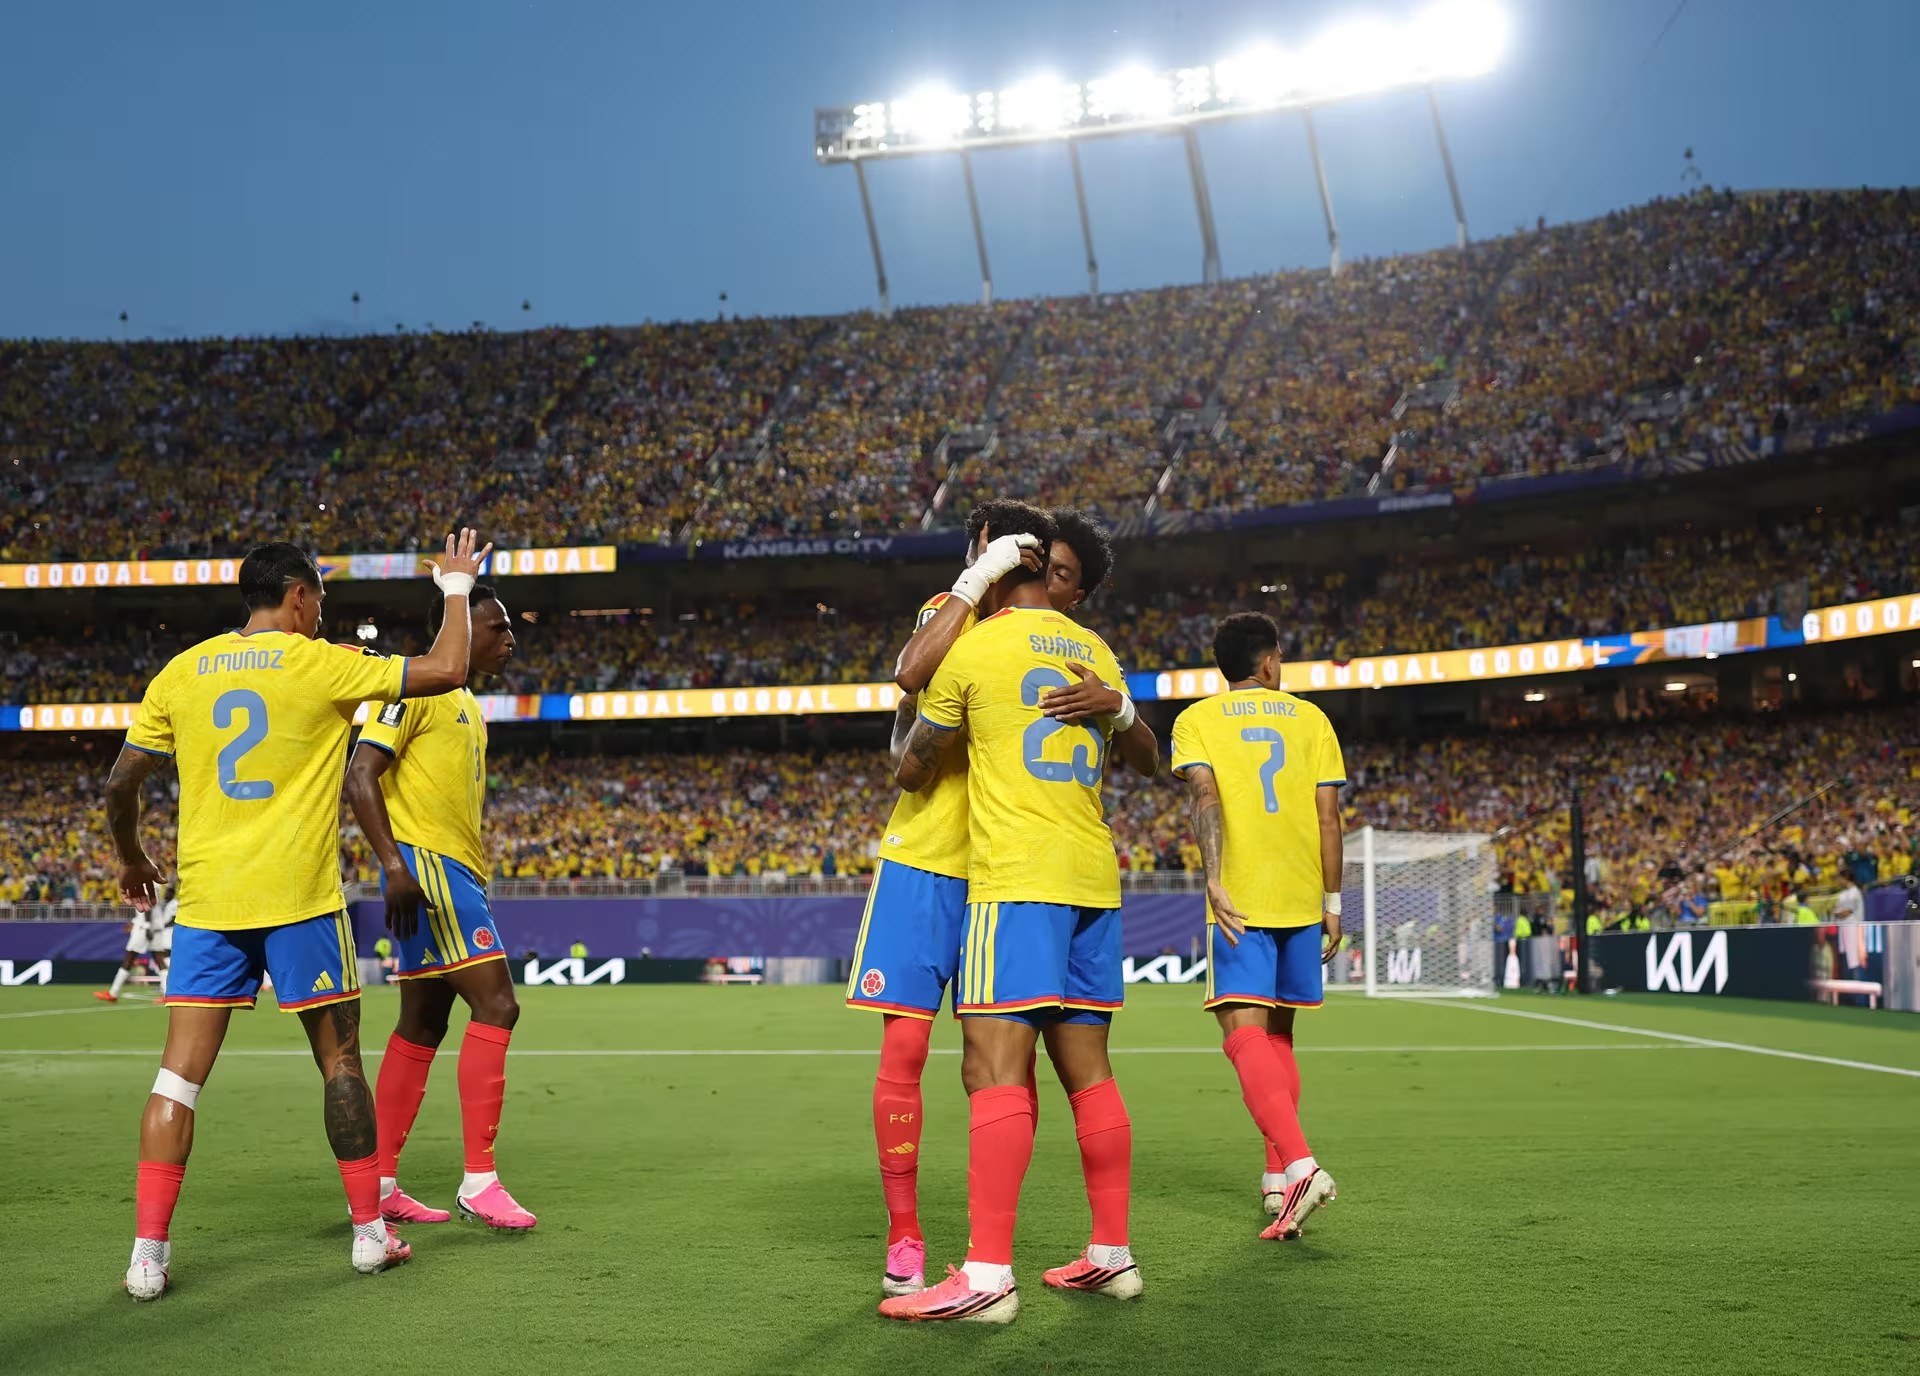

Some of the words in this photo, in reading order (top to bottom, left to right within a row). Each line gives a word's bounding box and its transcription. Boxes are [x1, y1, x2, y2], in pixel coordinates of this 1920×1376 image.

[723, 539, 831, 559] KANSAS
[24, 561, 155, 588] GOOOAL
[172, 560, 236, 585] GOO
[197, 647, 285, 676] D.MUÑOZ
[1029, 629, 1096, 665] SUÁREZ
[1469, 640, 1610, 677] GOOOAL
[1222, 701, 1257, 717] LUIS
[212, 688, 275, 801] 2
[1241, 727, 1285, 814] 7
